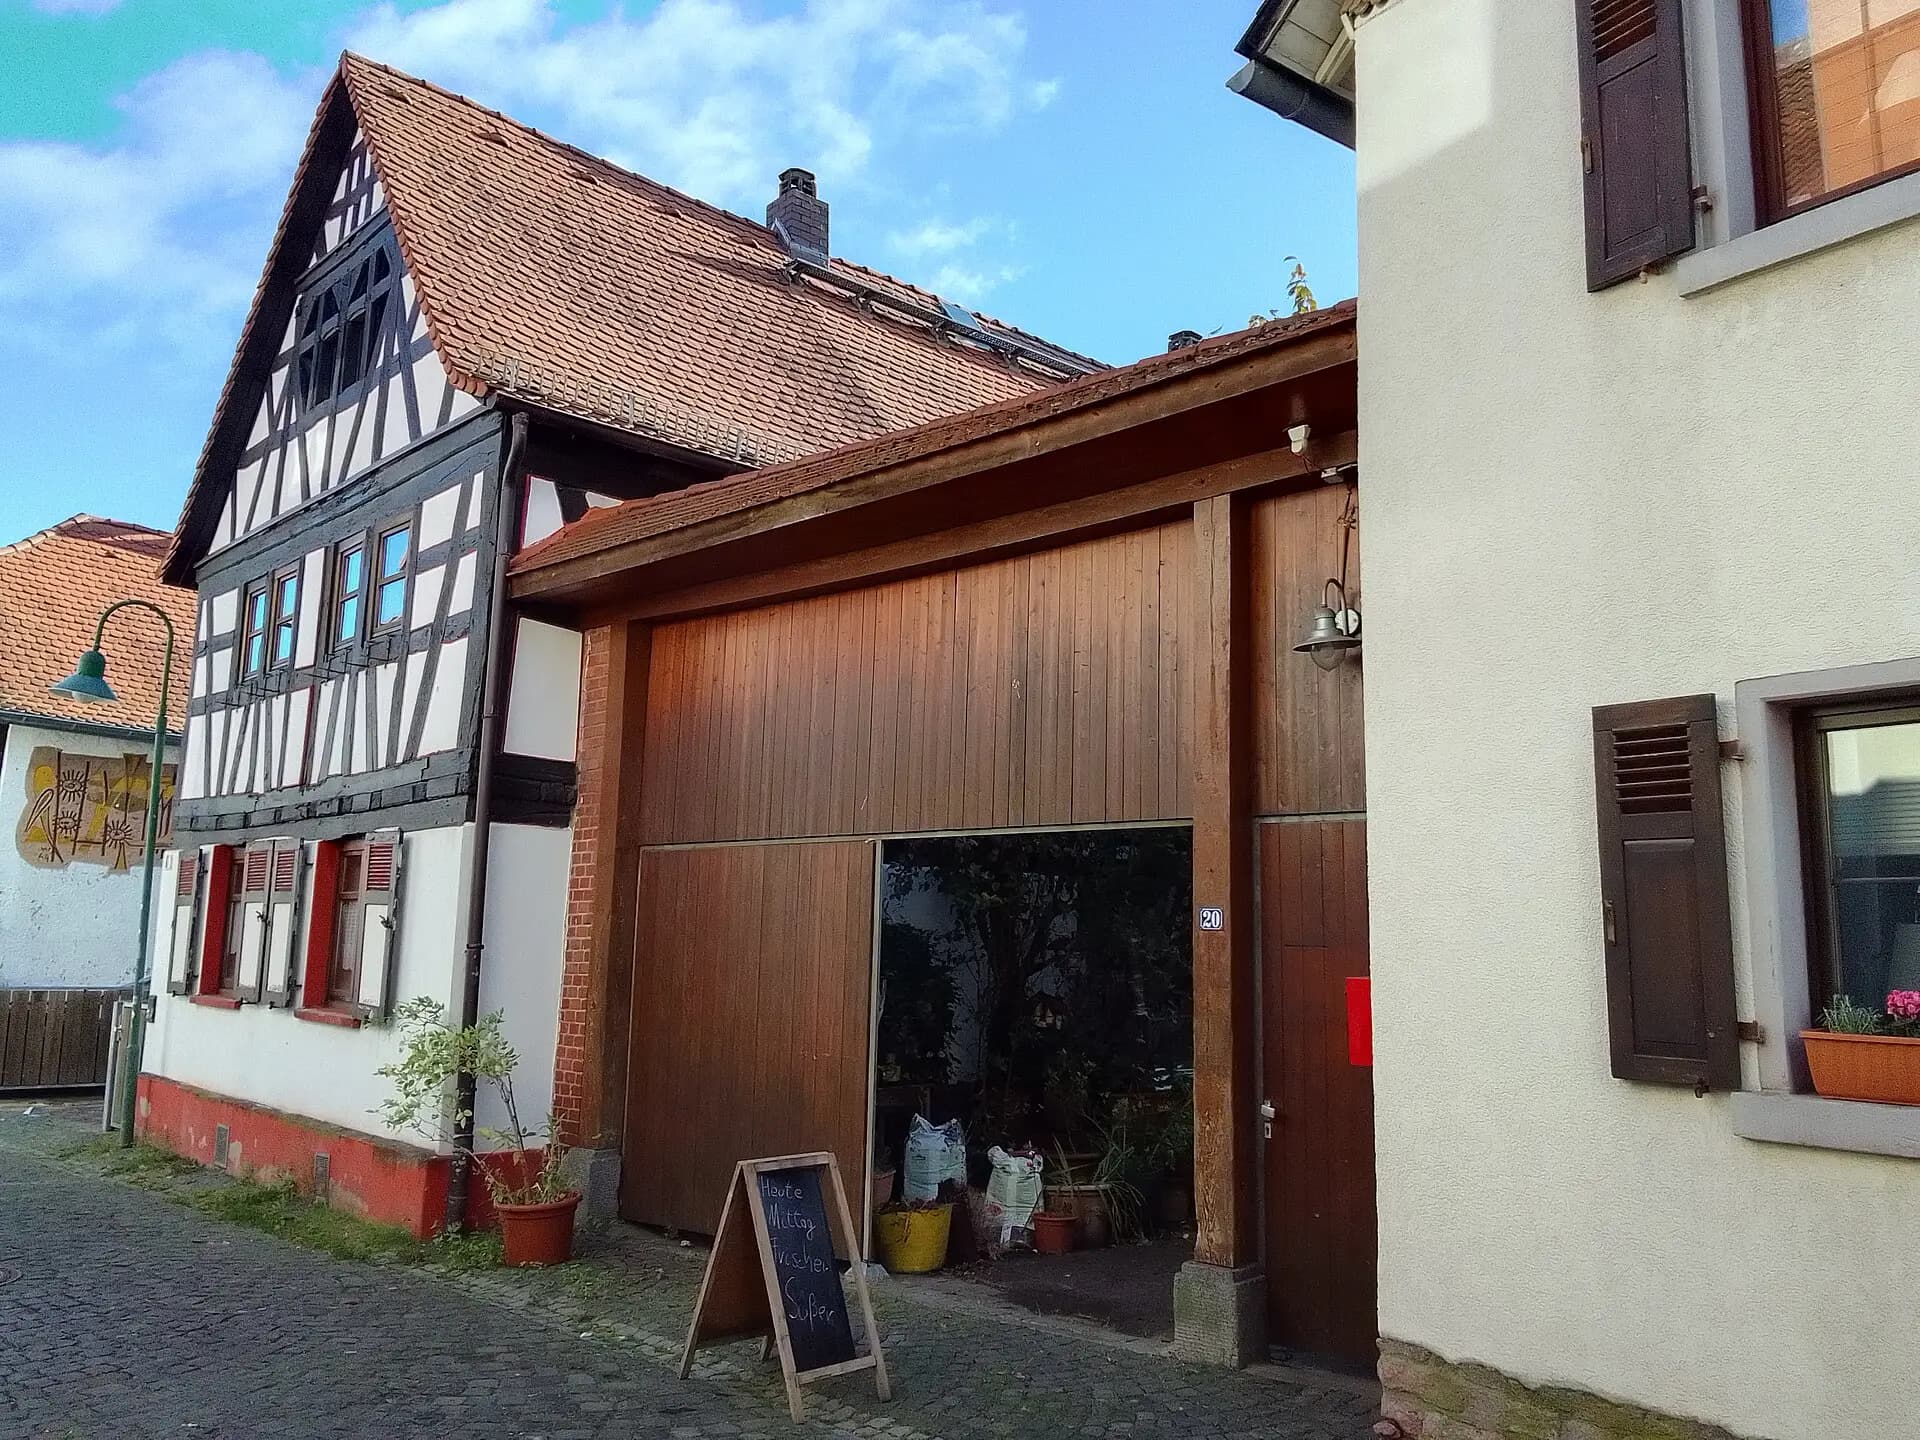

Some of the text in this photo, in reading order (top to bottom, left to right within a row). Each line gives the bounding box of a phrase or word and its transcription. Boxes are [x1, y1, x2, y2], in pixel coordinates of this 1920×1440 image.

[1202, 910, 1220, 928] 20
[760, 1175, 803, 1199] Heute
[768, 1203, 816, 1241] Mittag
